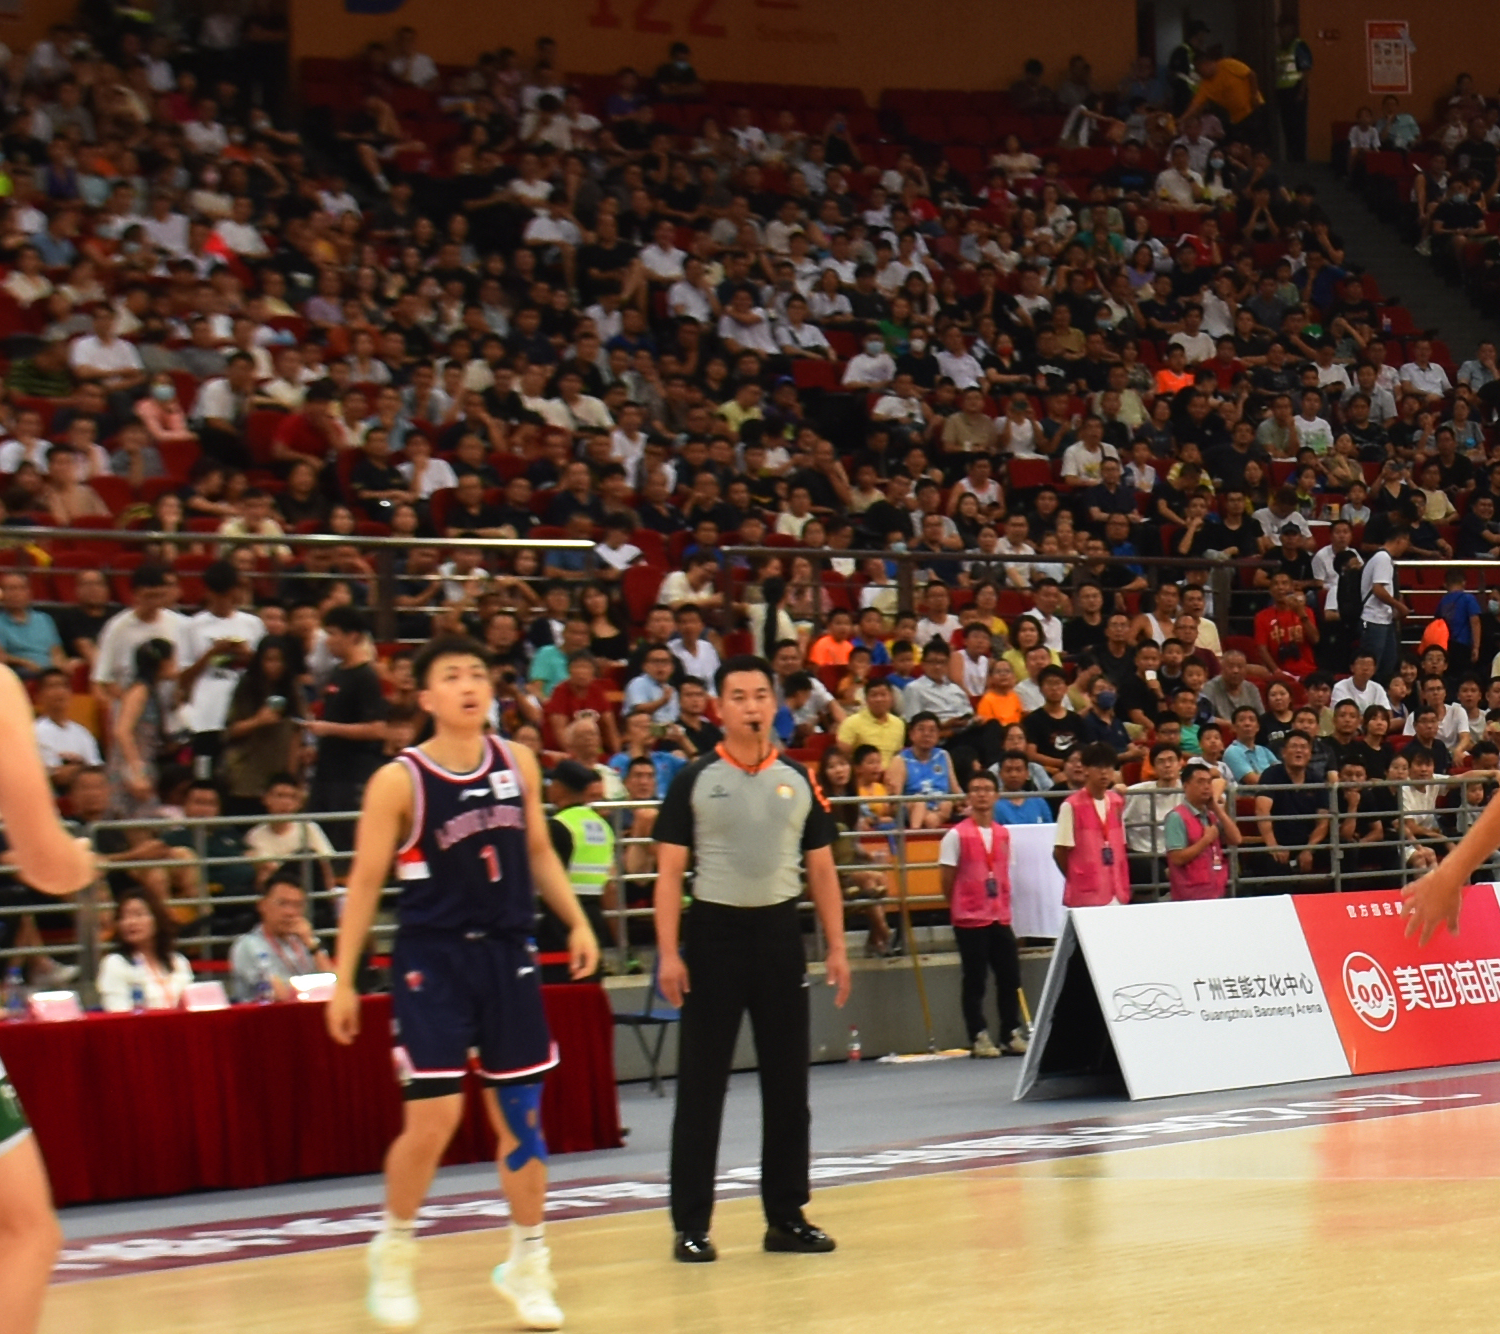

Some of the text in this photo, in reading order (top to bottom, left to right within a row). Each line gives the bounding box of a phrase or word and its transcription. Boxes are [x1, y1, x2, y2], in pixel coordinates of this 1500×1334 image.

[479, 844, 503, 883] 1
[1193, 971, 1314, 1002] 广州宝能文化中心
[1200, 1002, 1323, 1023] Guangzhou Baoneng Arena
